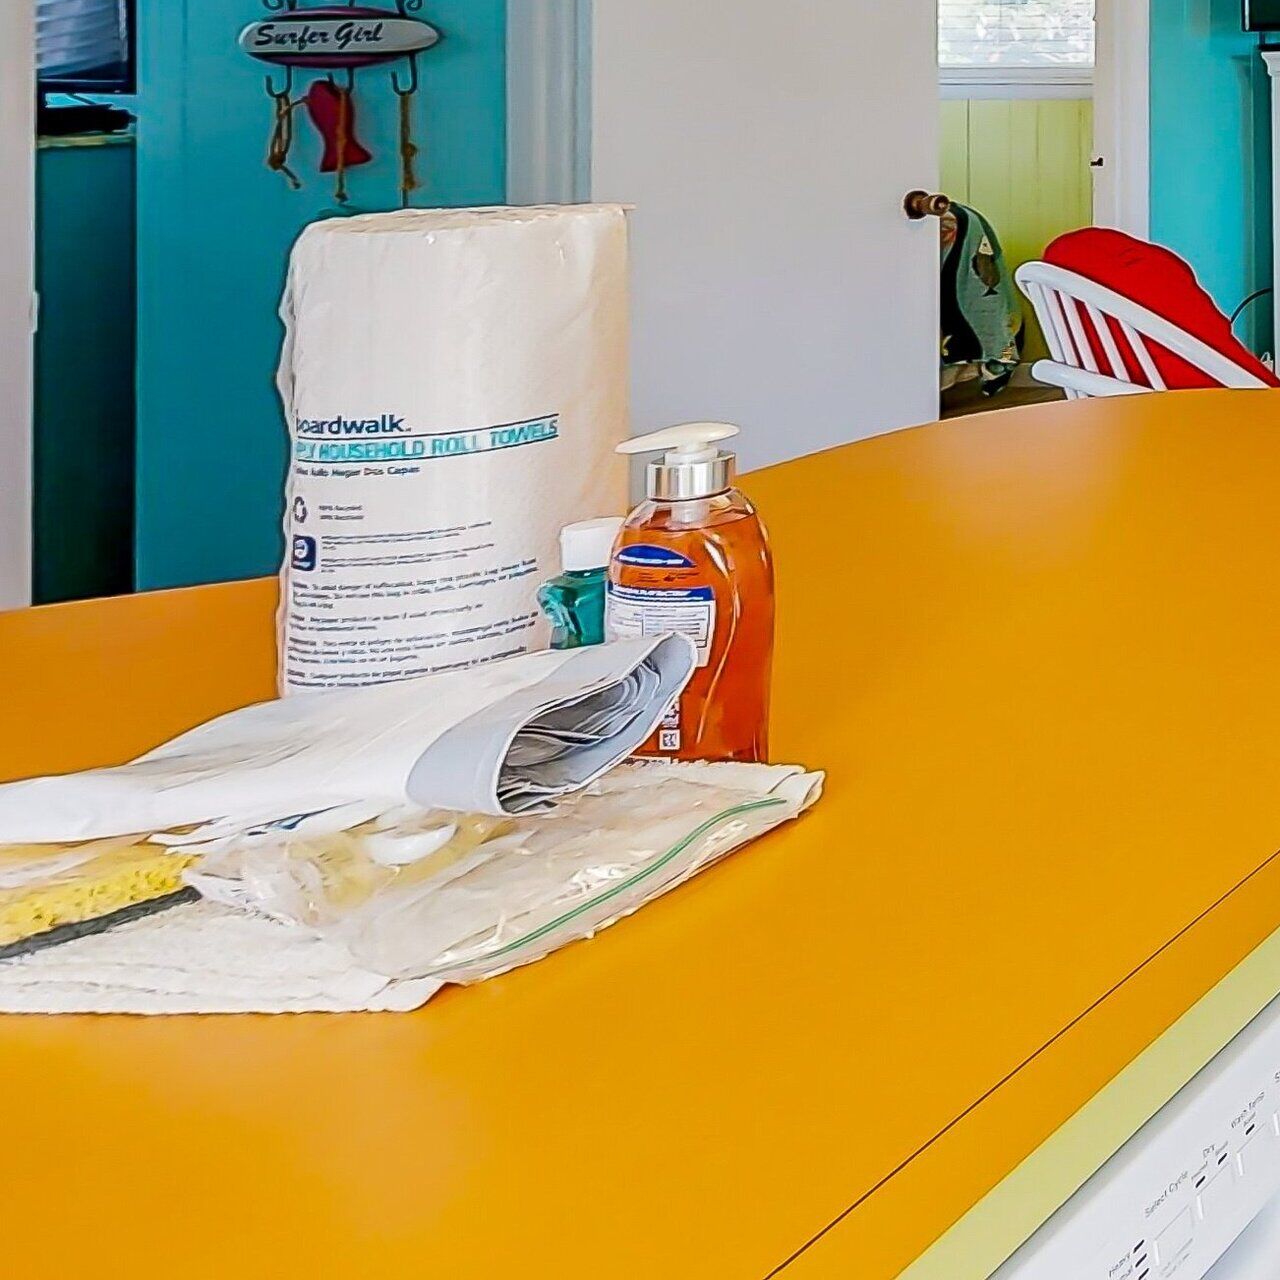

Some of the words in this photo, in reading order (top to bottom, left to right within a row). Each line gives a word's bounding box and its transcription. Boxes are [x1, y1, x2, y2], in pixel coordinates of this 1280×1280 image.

[254, 23, 330, 51] Surfer
[334, 22, 383, 50] Girl
[318, 440, 425, 460] HOUSEHOLD
[431, 435, 481, 455] ROLL
[489, 419, 558, 447] TOWELS
